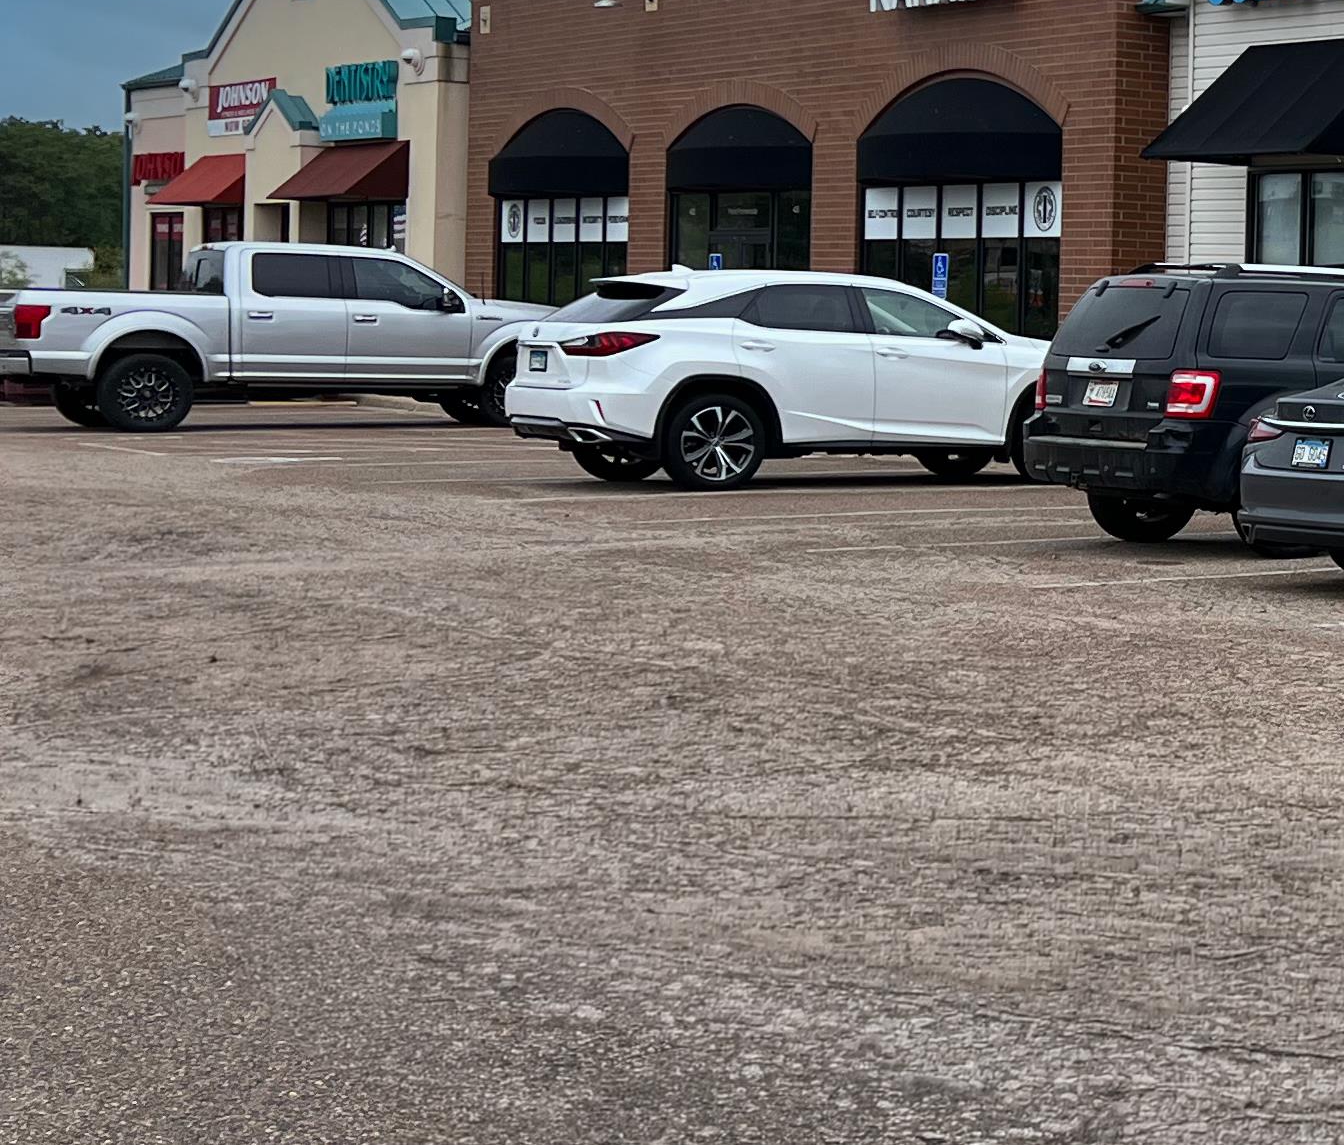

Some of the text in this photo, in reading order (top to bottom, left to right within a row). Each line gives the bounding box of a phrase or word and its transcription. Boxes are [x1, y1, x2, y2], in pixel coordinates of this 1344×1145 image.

[216, 81, 270, 113] JOHNSON
[325, 61, 398, 105] DENTISTRY
[336, 121, 350, 135] THE
